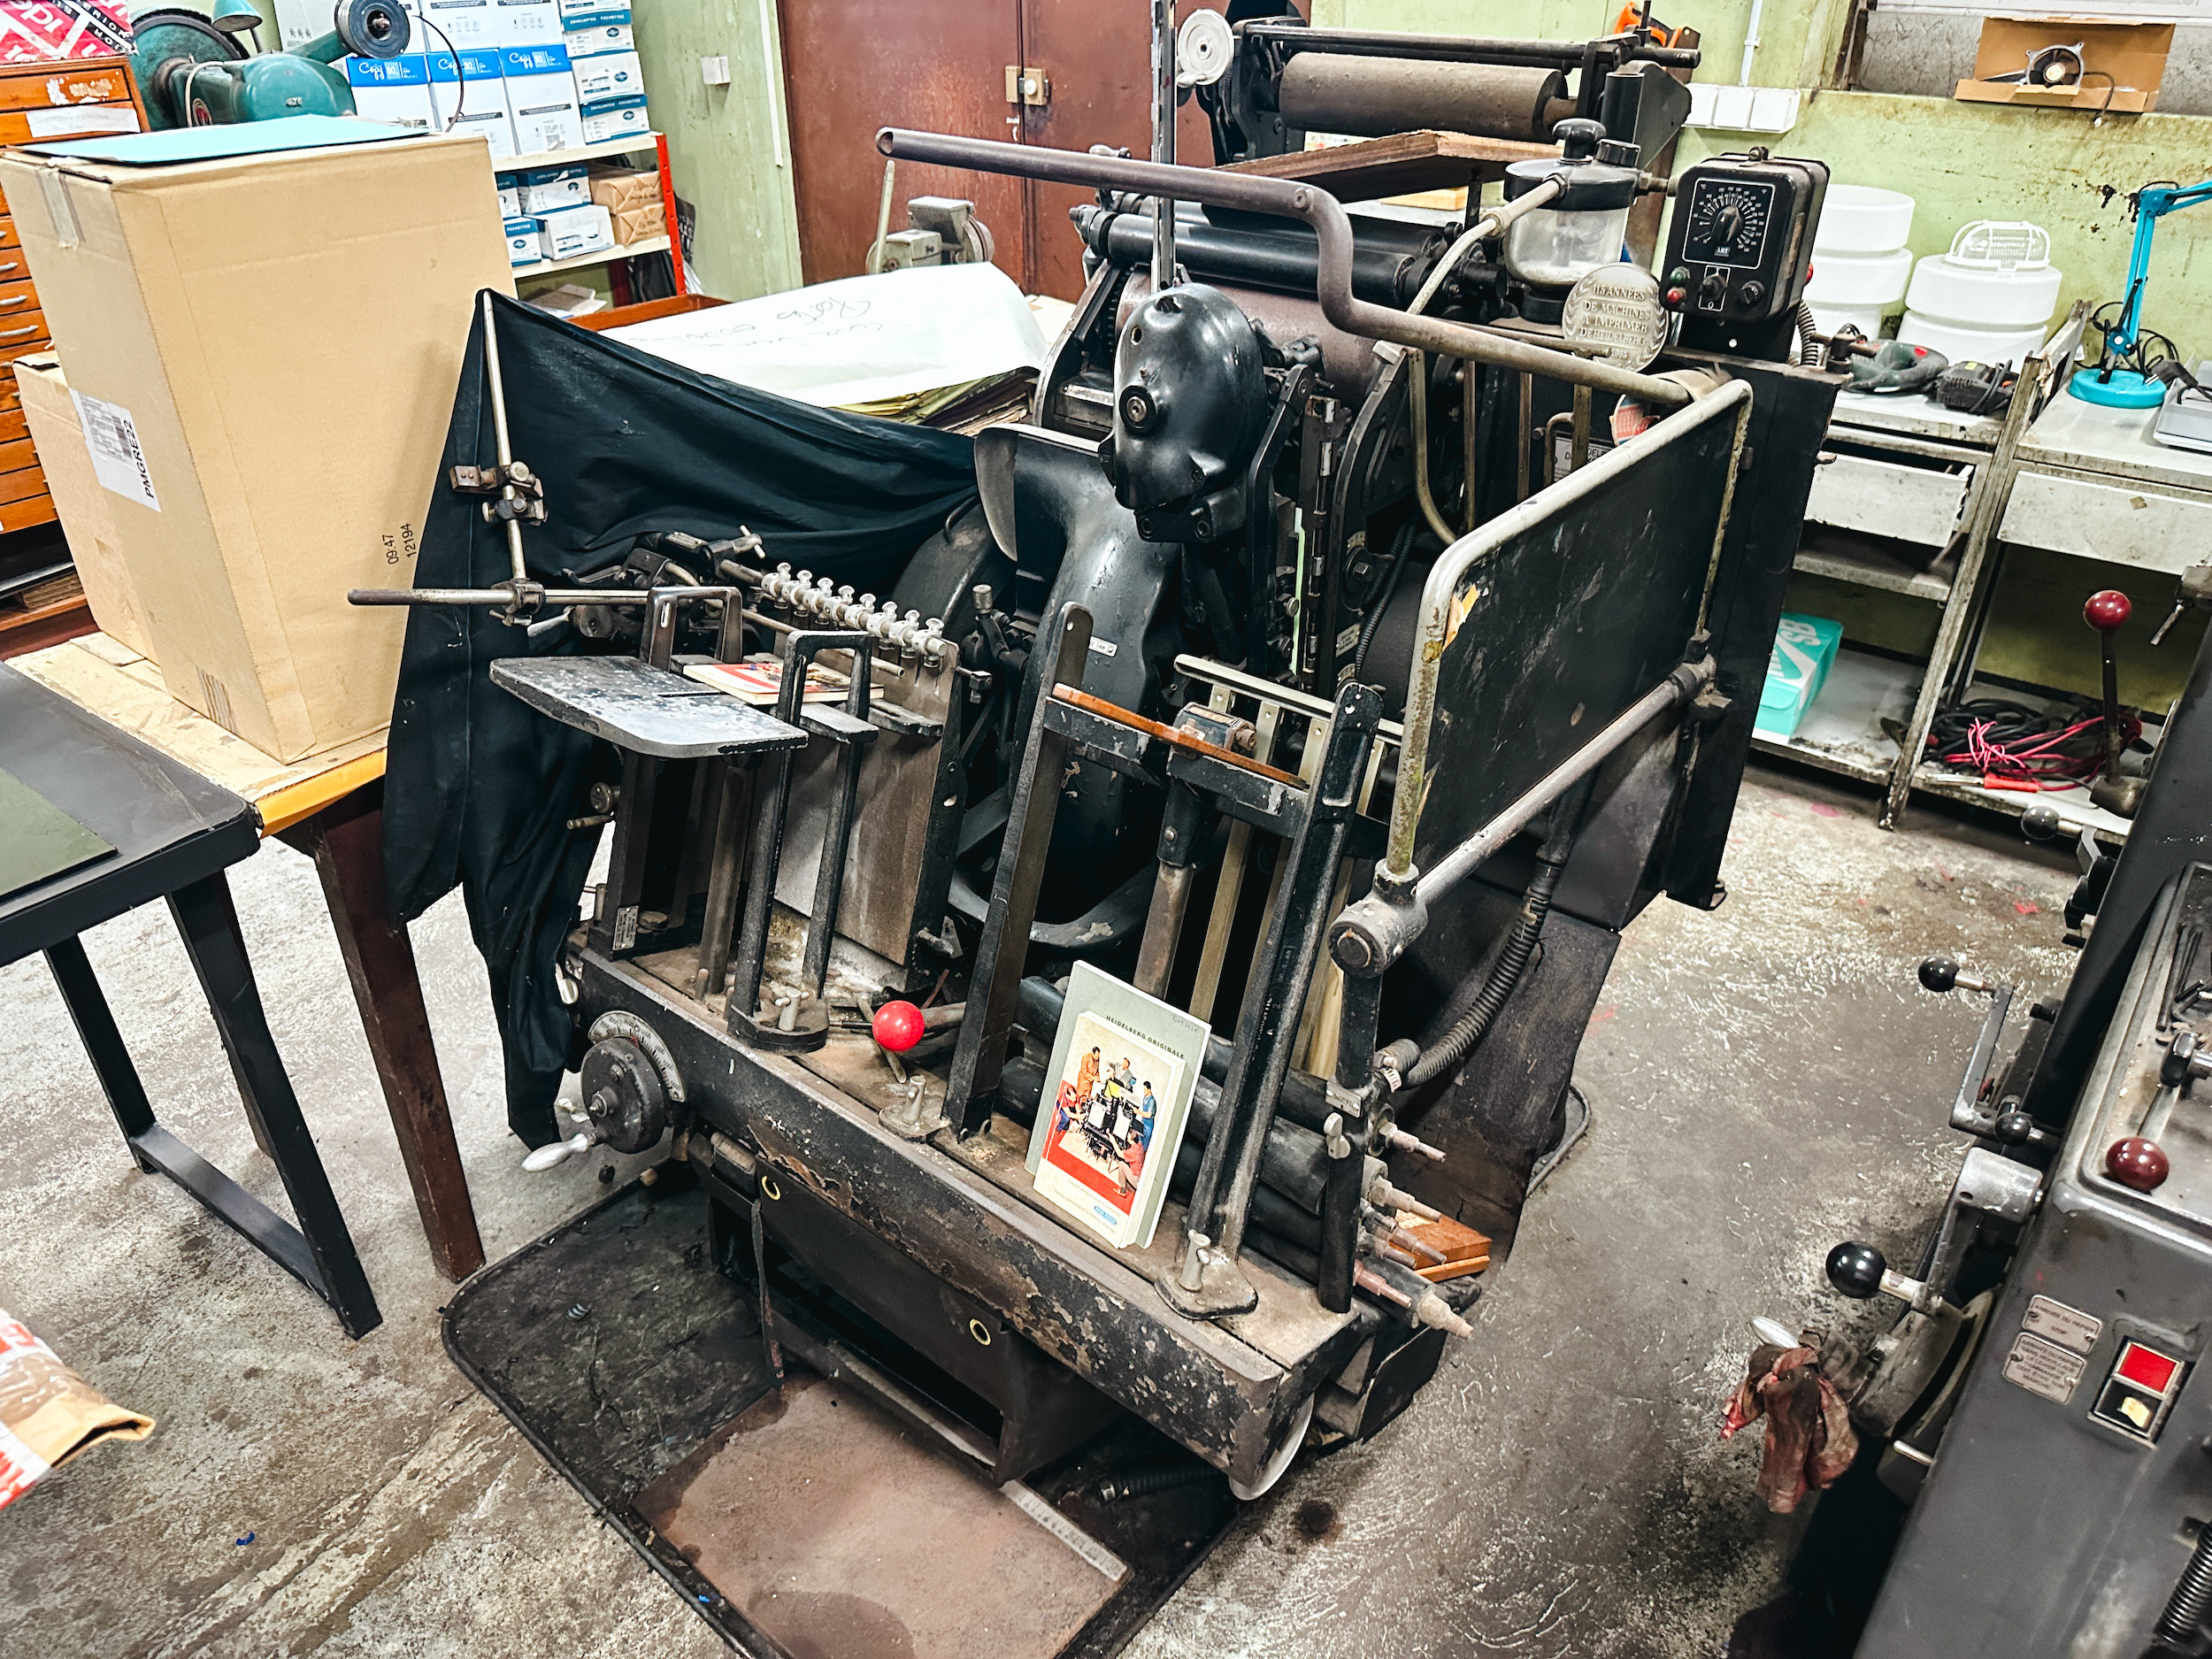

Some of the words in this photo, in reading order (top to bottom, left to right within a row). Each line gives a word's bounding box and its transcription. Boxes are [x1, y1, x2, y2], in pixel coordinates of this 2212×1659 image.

[509, 52, 534, 69] Copy
[358, 62, 385, 81] Copy
[1583, 300, 1598, 312] DE
[1600, 302, 1652, 320] MACHINES
[1593, 316, 1648, 334] IMPRIMER
[1579, 327, 1593, 339] DE
[1593, 328, 1647, 347] HEIDELBERG
[123, 419, 155, 498] PMGRE22
[382, 534, 399, 565] 09:47
[400, 523, 417, 558] 12194
[1106, 1015, 1146, 1040] HEIDELBERG
[1148, 1037, 1185, 1060] ORIGINALE
